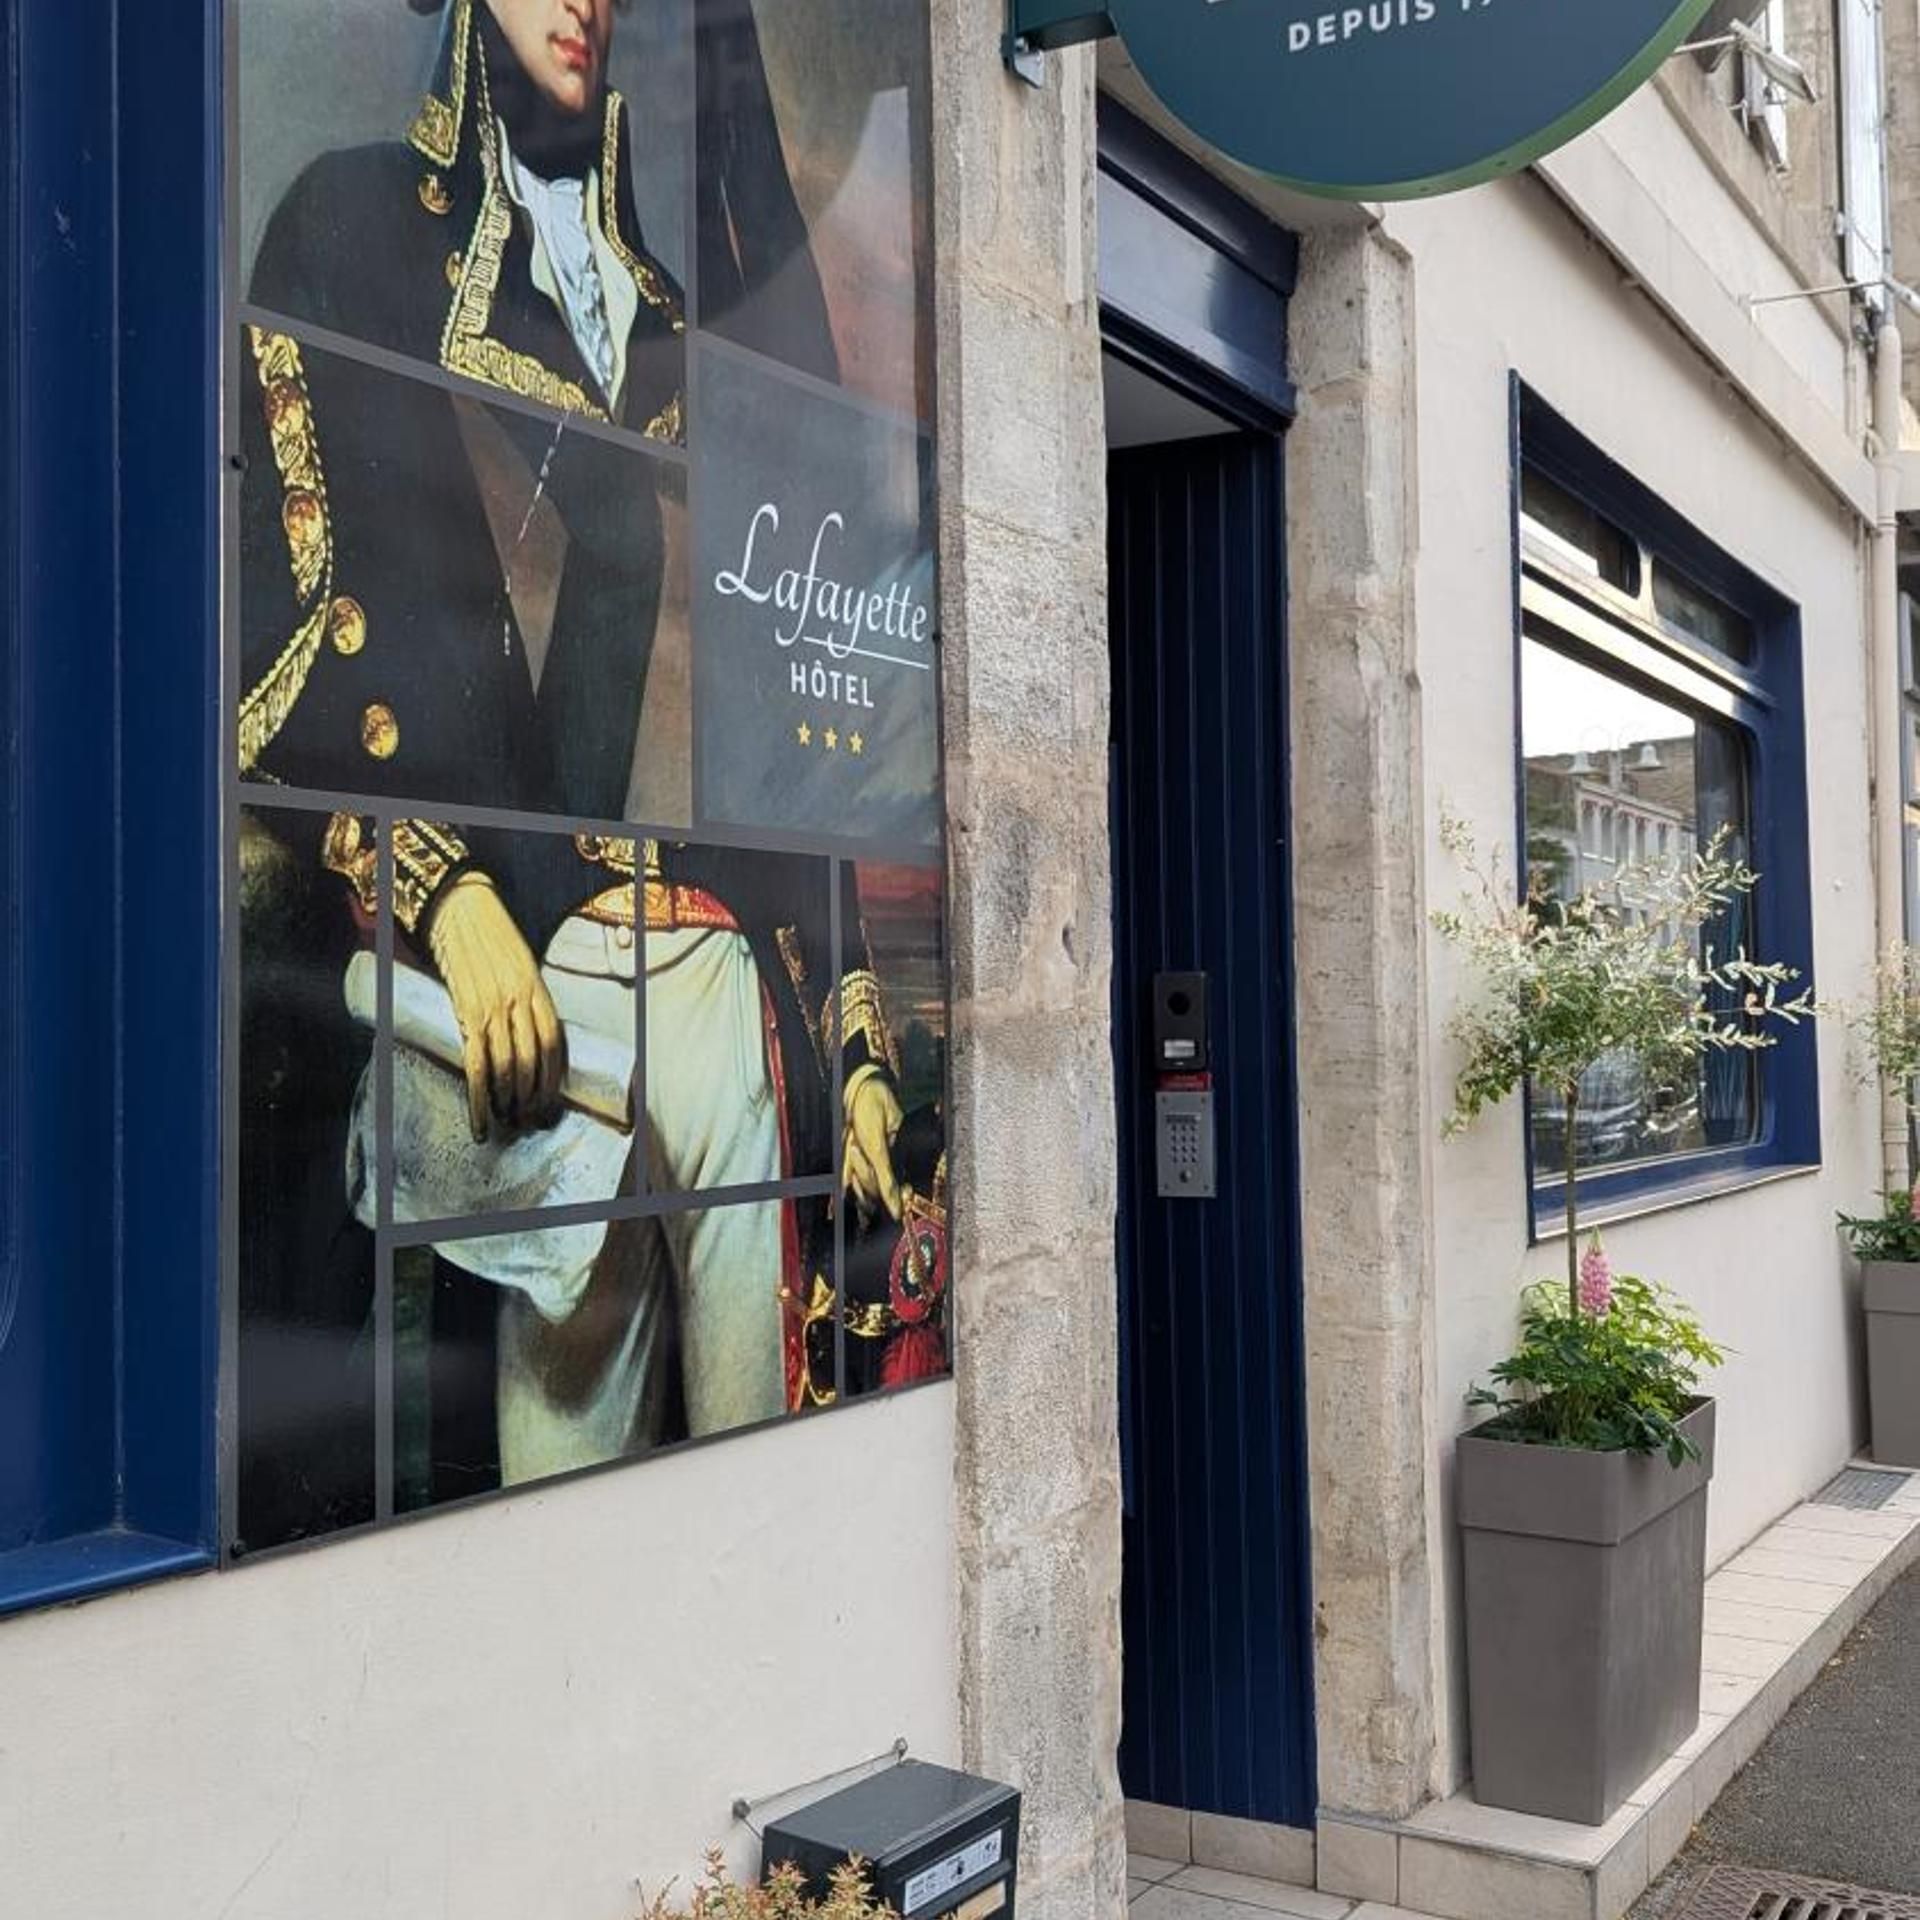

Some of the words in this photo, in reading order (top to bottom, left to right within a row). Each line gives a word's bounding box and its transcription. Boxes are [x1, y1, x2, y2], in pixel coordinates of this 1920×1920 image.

[1288, 0, 1436, 51] DEPUIS
[714, 503, 928, 659] Lafayette
[790, 659, 875, 708] HÔTEL
